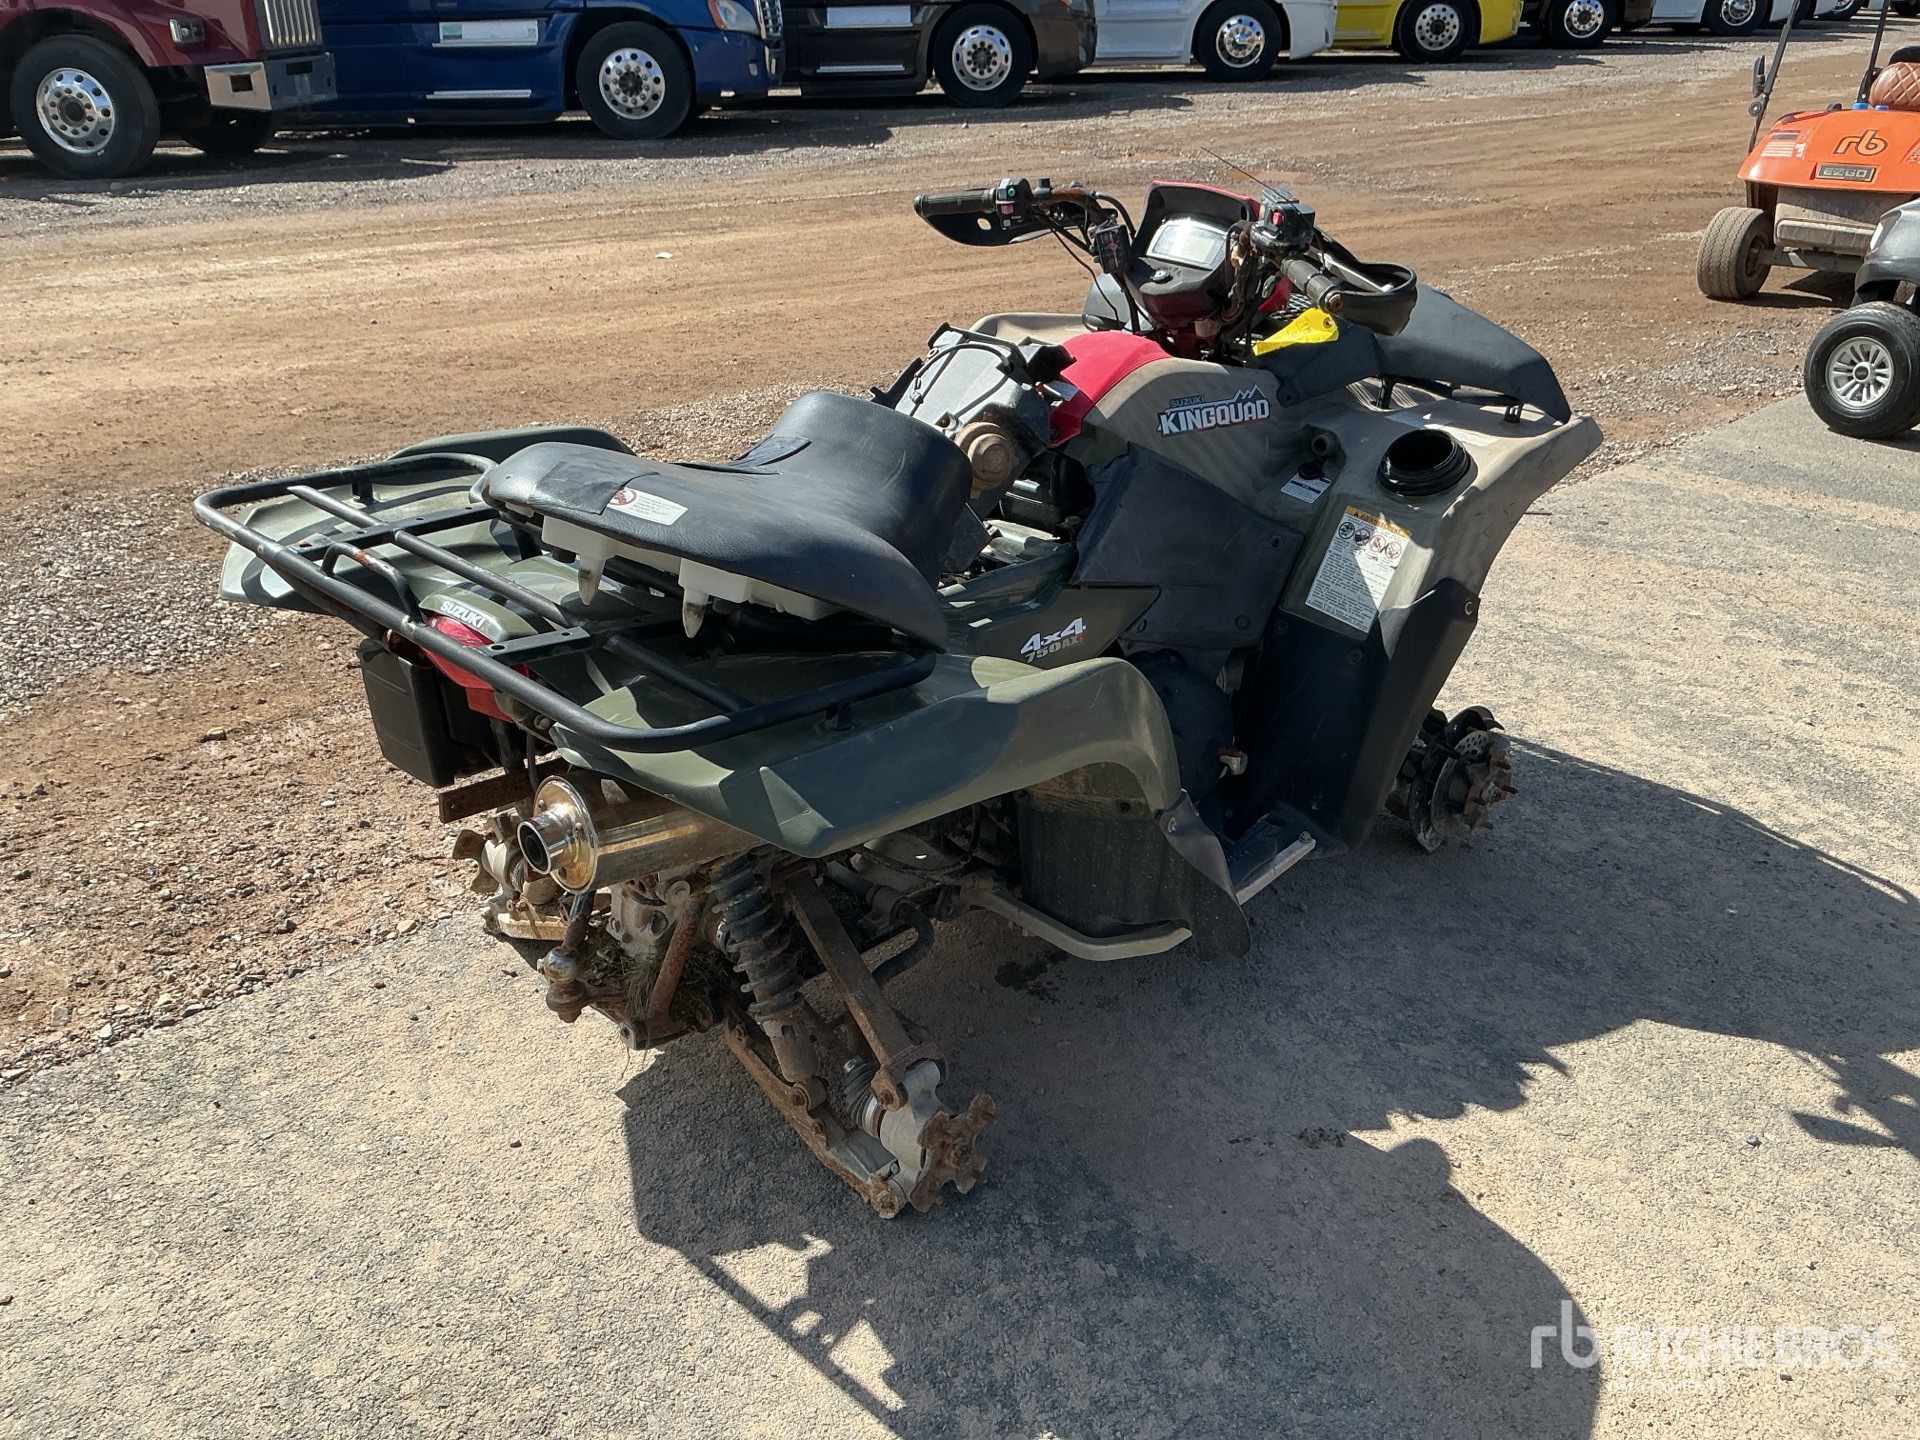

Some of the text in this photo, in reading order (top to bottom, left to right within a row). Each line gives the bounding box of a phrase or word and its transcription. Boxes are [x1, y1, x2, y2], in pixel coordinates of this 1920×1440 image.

[1833, 129, 1889, 157] rb
[1169, 395, 1205, 409] SUZUKI
[1160, 399, 1271, 435] KINGQUAD
[440, 600, 488, 629] SUZUKI
[1020, 617, 1085, 655] 4x4
